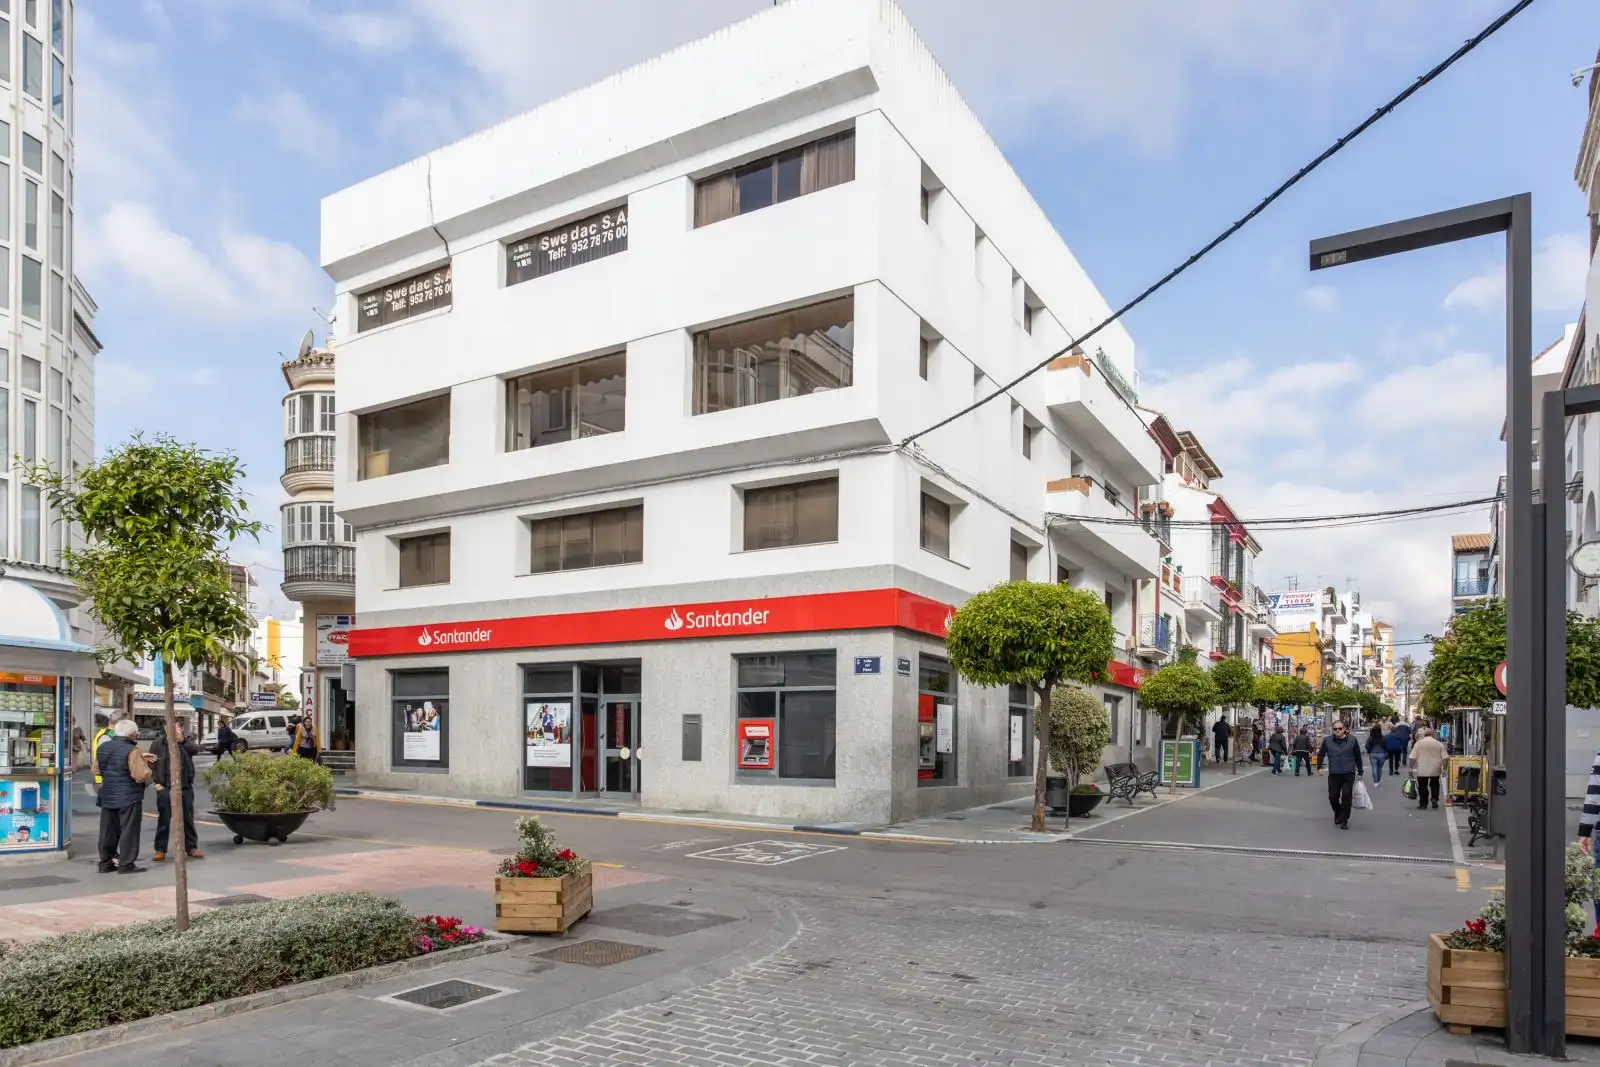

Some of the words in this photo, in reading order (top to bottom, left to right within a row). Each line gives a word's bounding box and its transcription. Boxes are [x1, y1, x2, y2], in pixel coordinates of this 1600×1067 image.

[572, 238, 588, 254] 952
[590, 235, 600, 247] 78
[602, 230, 613, 243] 76
[616, 225, 627, 238] 00
[410, 293, 423, 305] 952
[434, 285, 443, 297] 76
[686, 609, 770, 629] Santander
[434, 629, 492, 645] Santander
[305, 675, 313, 717] ITAC
